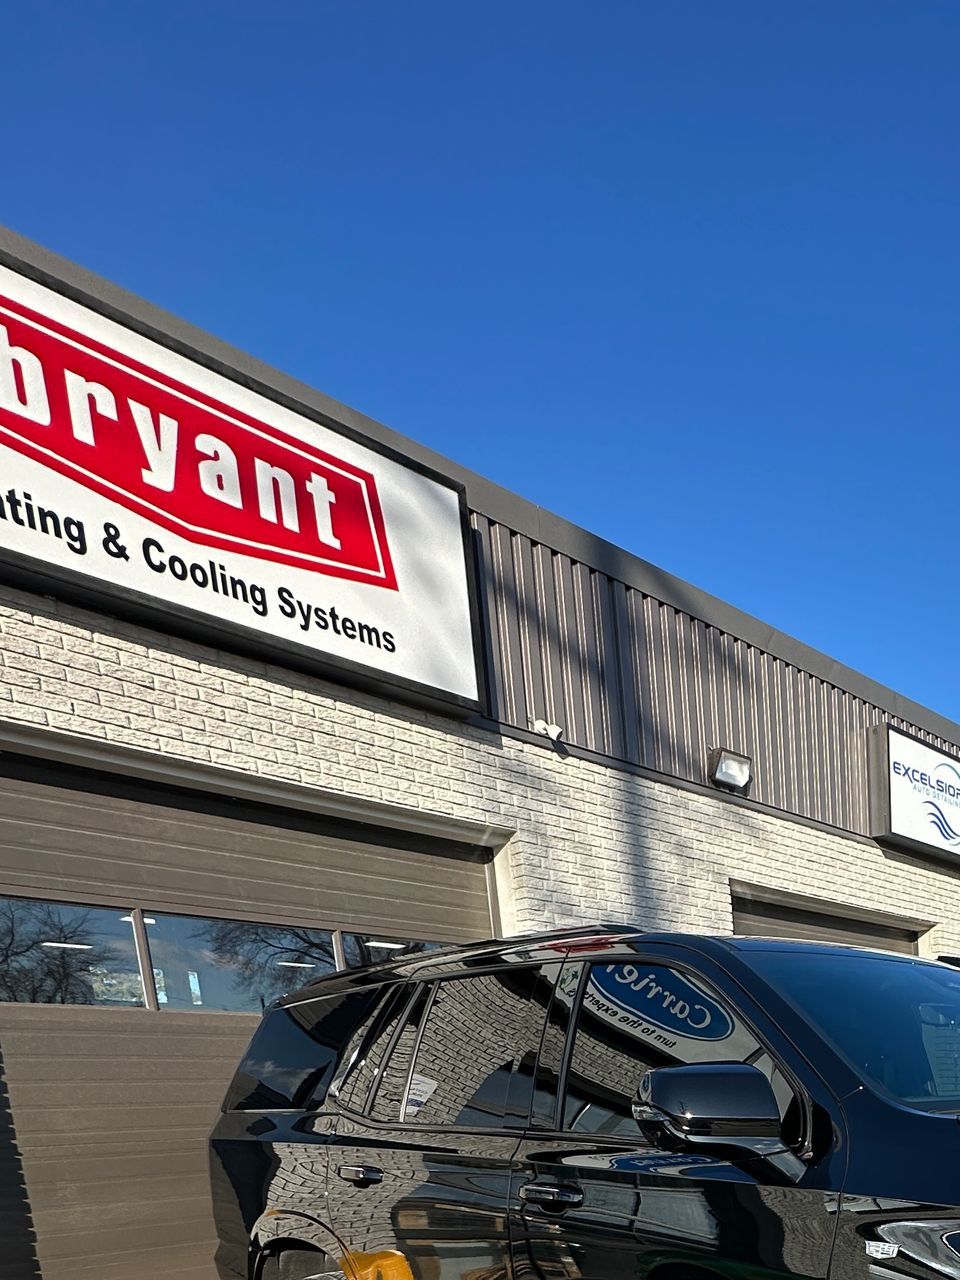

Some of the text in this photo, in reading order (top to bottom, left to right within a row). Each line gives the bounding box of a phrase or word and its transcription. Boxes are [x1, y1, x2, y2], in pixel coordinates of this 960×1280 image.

[0, 324, 341, 551] bryant
[0, 488, 396, 653] ting & Cooling Systems
[912, 784, 931, 797] AUTO
